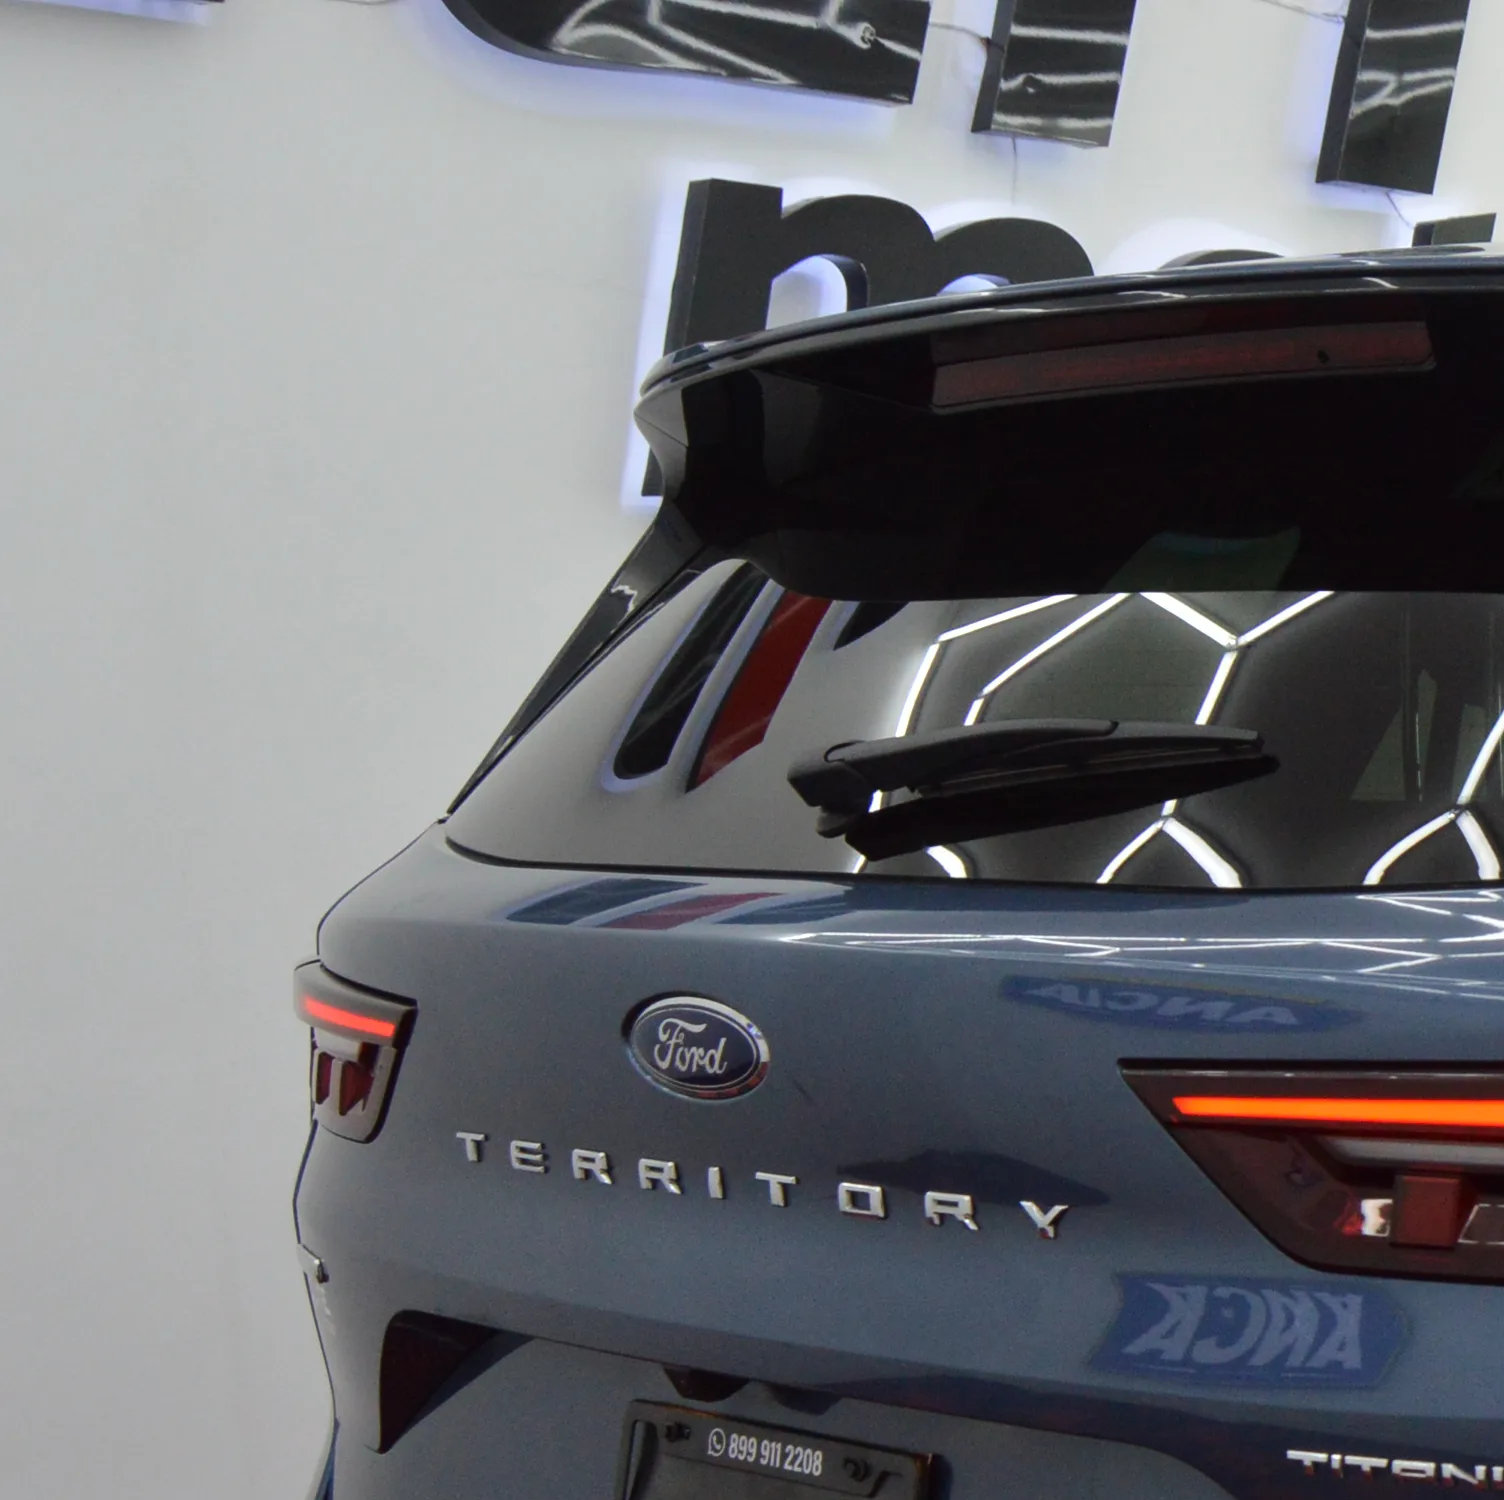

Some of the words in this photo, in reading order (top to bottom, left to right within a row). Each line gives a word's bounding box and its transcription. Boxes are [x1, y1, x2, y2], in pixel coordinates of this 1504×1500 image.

[653, 1016, 728, 1077] Ford
[455, 1131, 1069, 1239] TERRITORY
[728, 1433, 757, 1461] 899
[760, 1440, 782, 1468] 911
[784, 1445, 823, 1477] 2208
